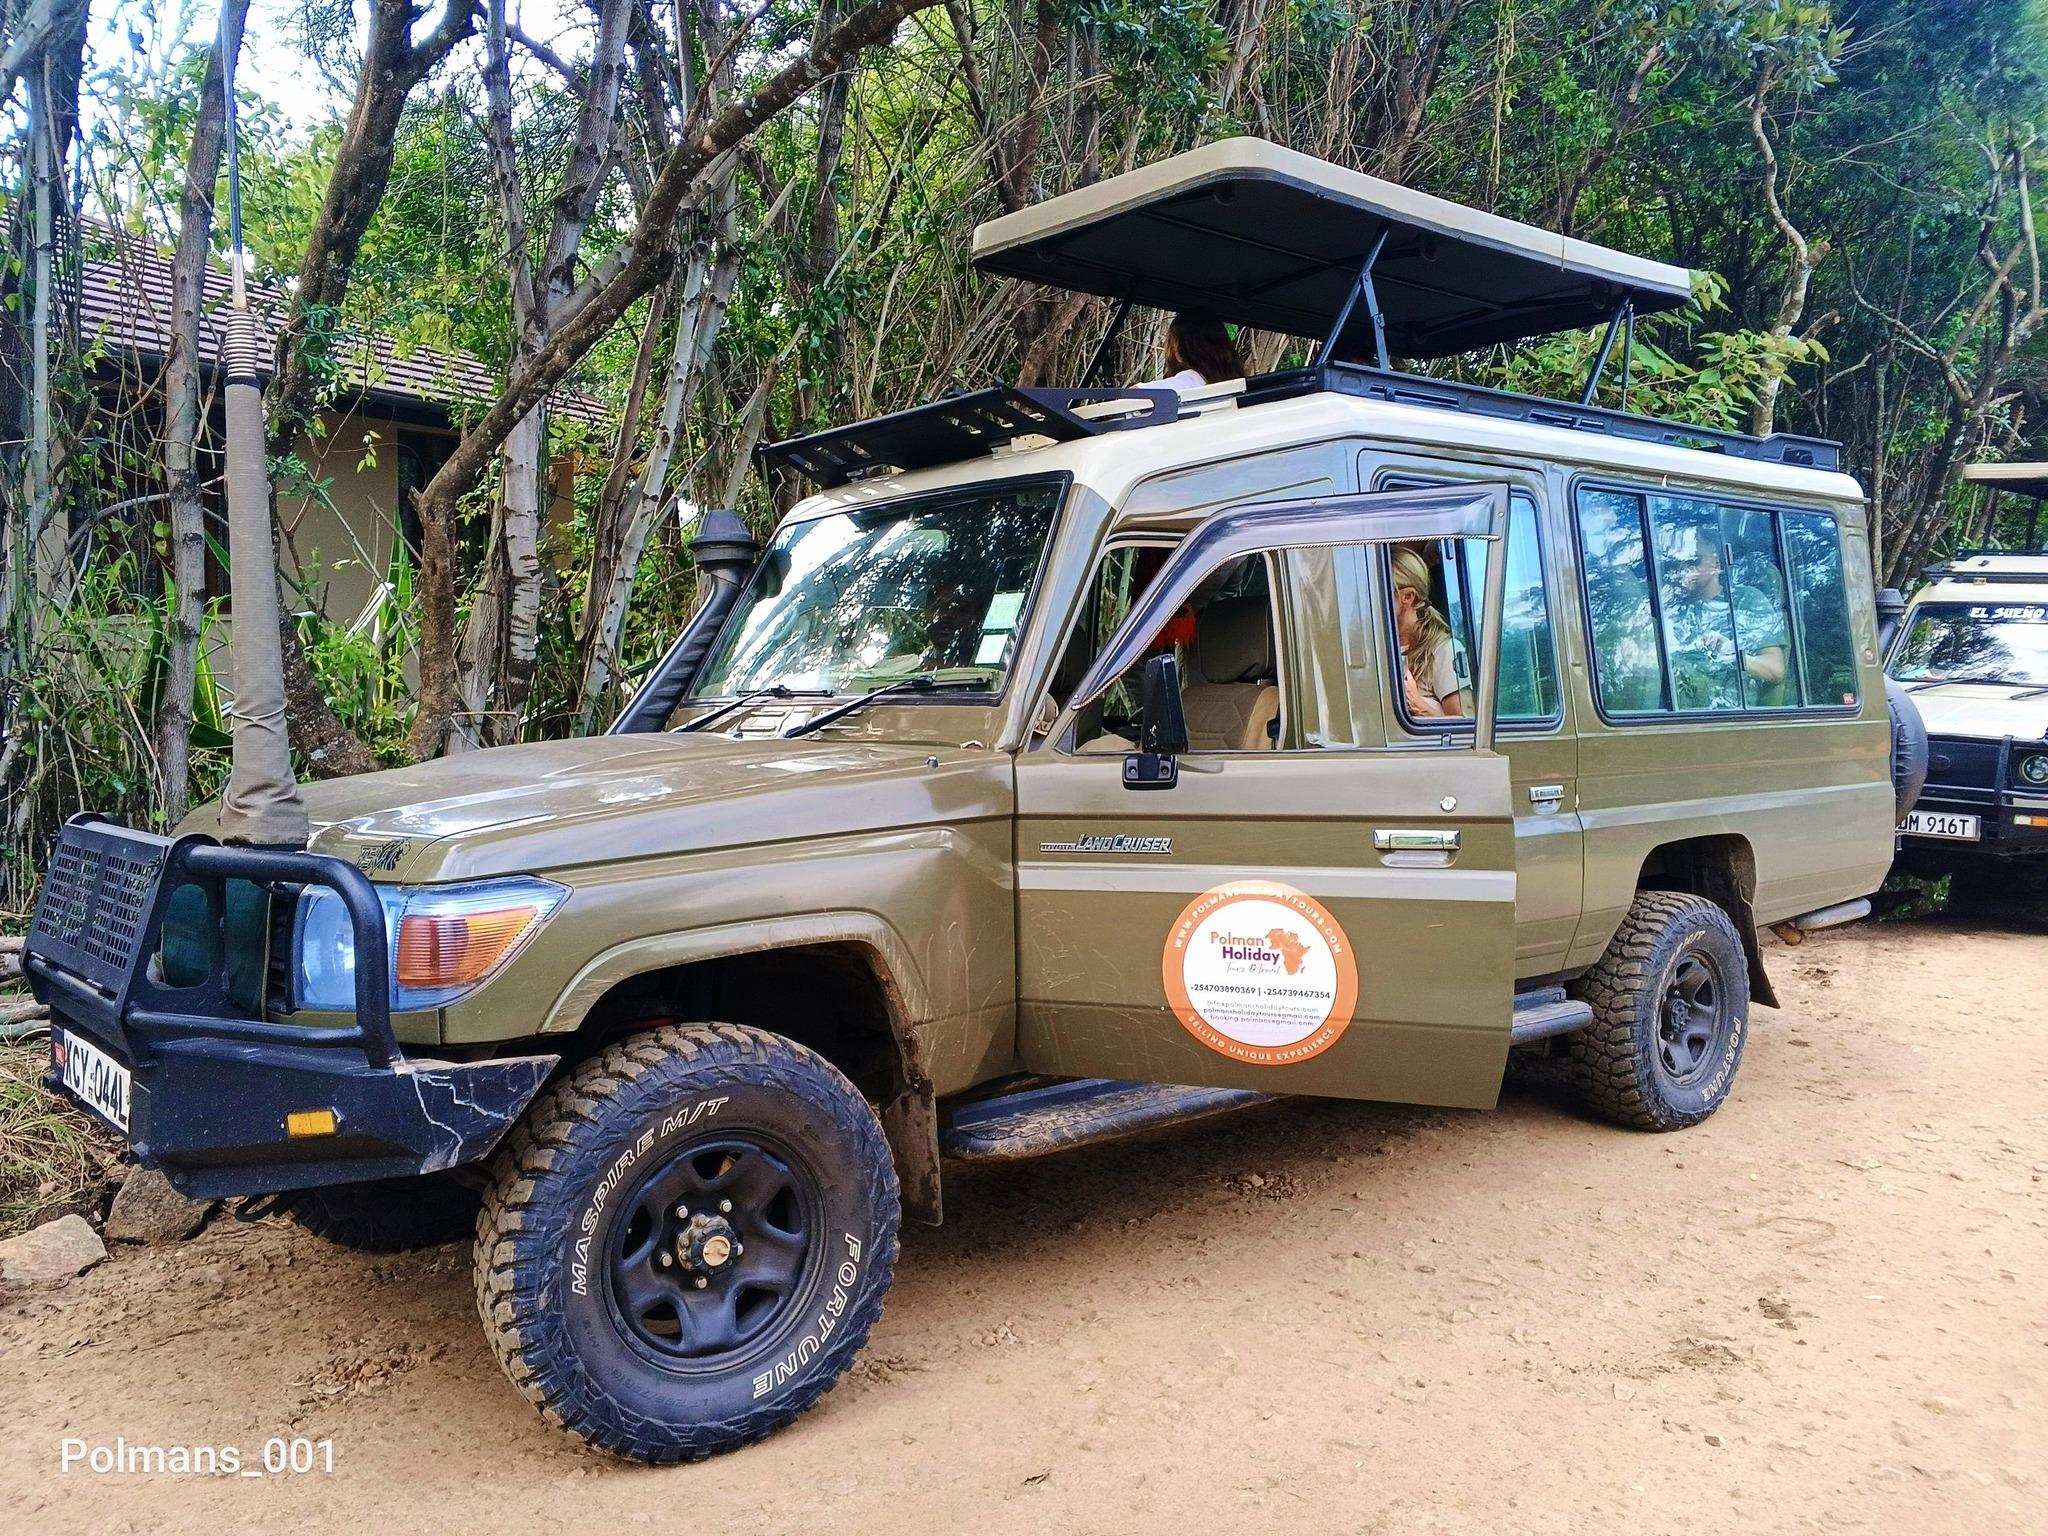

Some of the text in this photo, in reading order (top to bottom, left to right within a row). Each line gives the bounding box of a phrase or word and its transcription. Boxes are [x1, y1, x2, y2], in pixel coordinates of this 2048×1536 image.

[1970, 605, 2046, 619] EL SUEÑO
[1927, 816, 1969, 835] 916T
[1210, 931, 1265, 947] Polman
[1222, 946, 1280, 965] Holiday
[1188, 1015, 1335, 1060] SELLING UNIQUE EXPERIENCE
[1702, 1016, 1742, 1102] FORTUNE
[95, 1058, 128, 1126] 044L
[571, 1095, 730, 1297] MASPIRE M/T
[752, 1232, 862, 1400] FORTUNE
